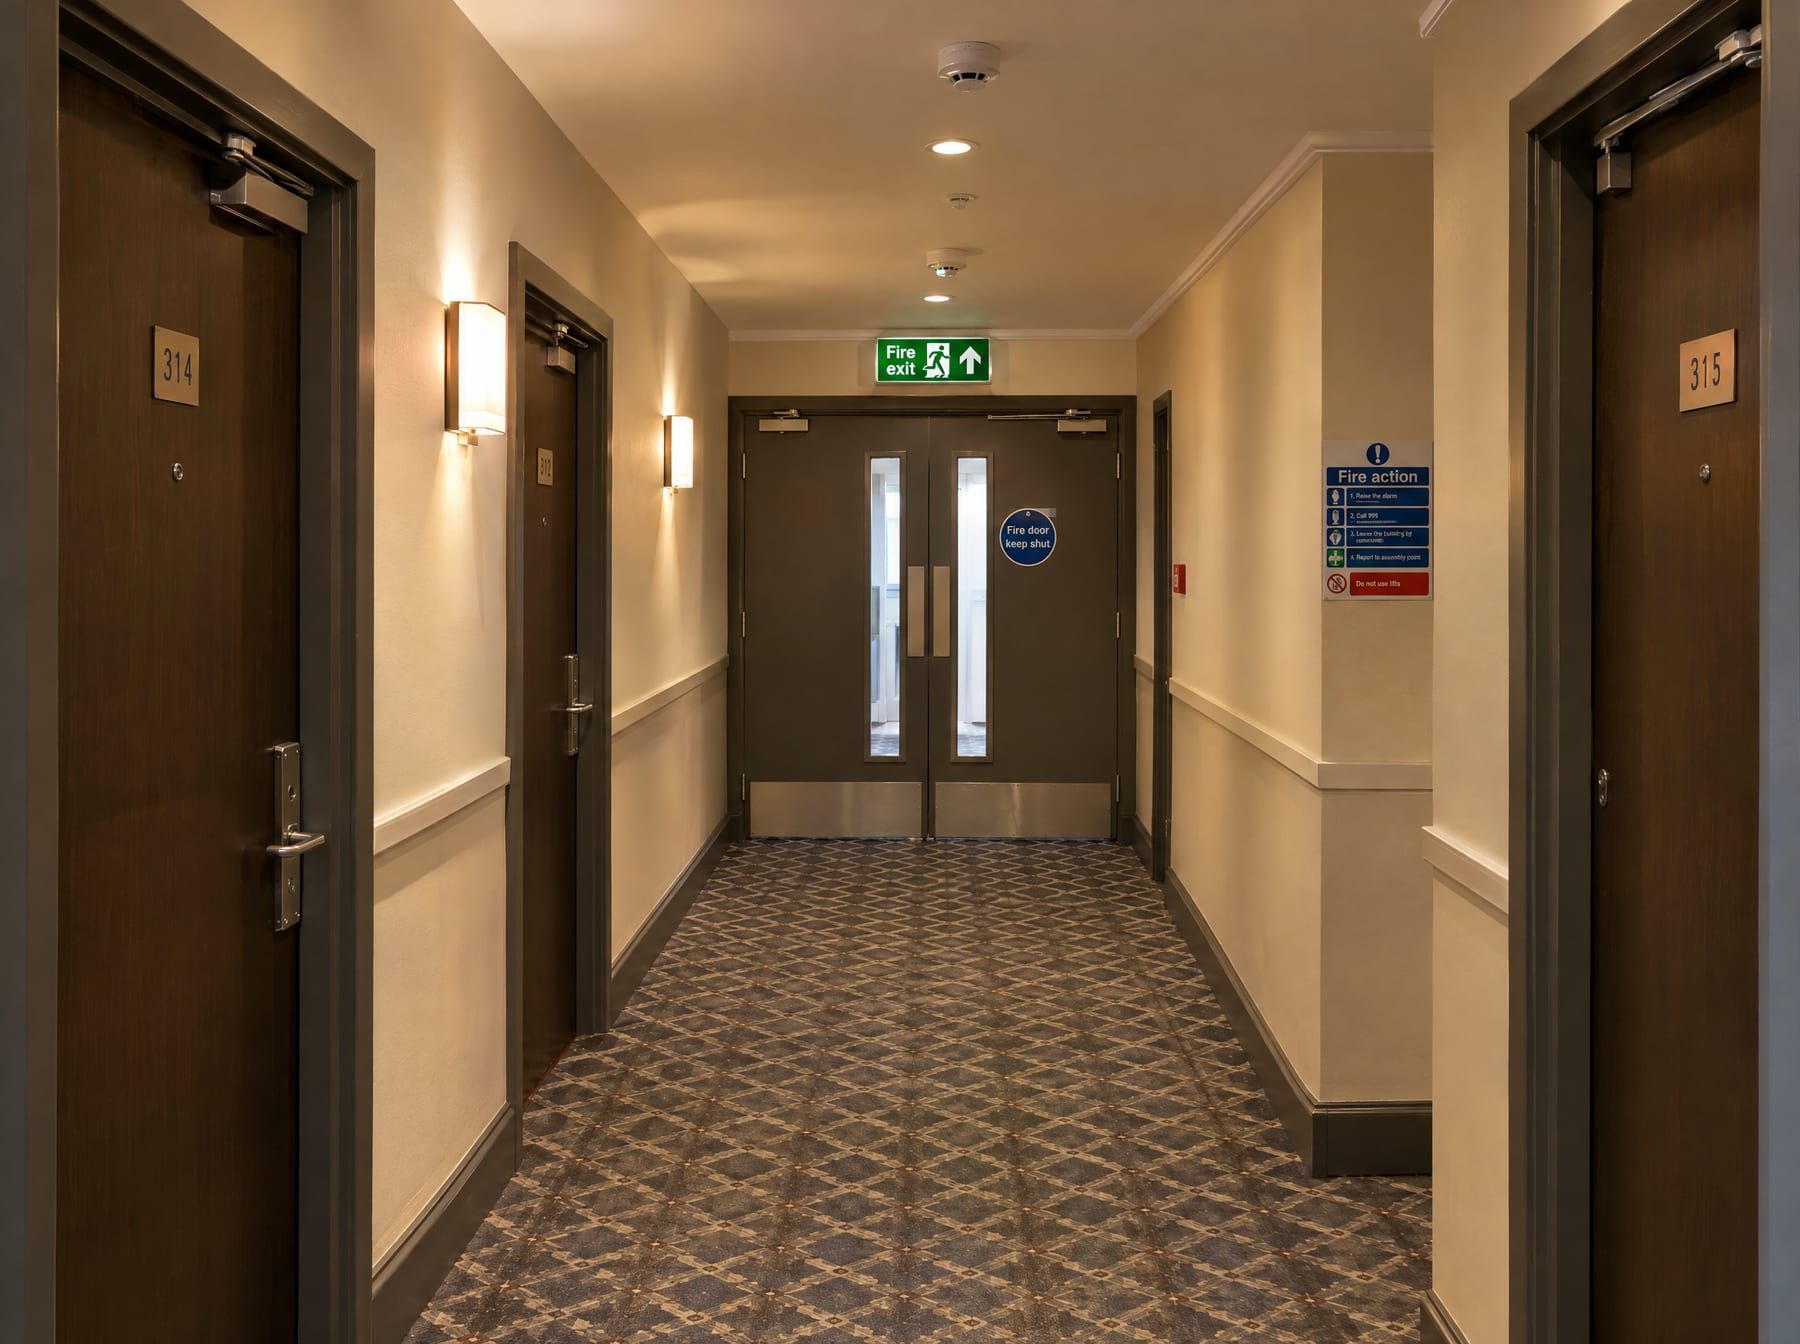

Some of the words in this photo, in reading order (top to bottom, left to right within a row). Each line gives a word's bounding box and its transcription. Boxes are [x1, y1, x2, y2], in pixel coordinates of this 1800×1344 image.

[886, 344, 916, 360] Fire
[164, 347, 192, 387] 314
[886, 361, 916, 376] exit
[1690, 351, 1721, 391] 315
[1338, 469, 1367, 483] Fire
[1371, 469, 1418, 483] action
[1007, 525, 1025, 535] Fire
[1027, 525, 1050, 535] door
[1005, 539, 1028, 550] keep
[1030, 539, 1051, 548] shut
